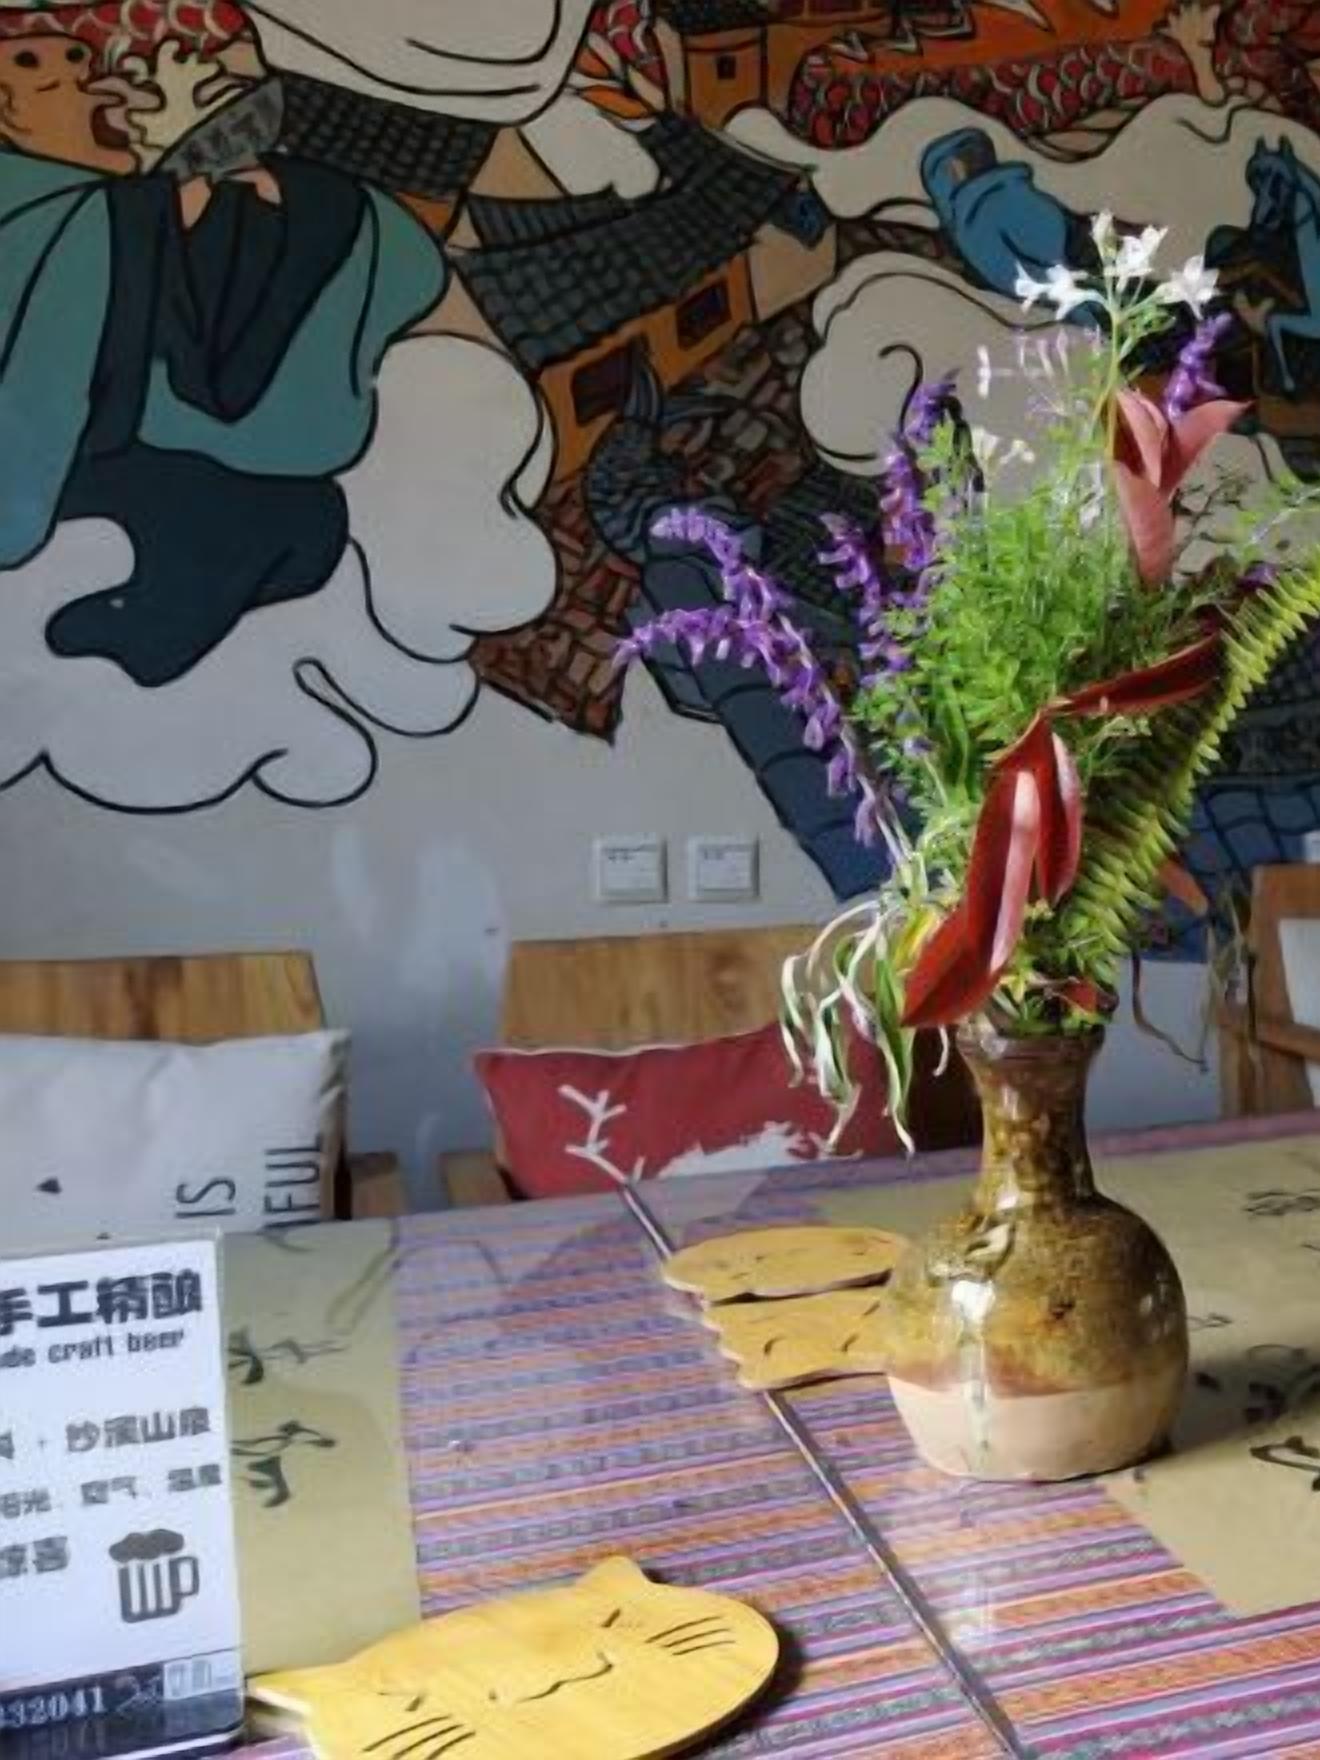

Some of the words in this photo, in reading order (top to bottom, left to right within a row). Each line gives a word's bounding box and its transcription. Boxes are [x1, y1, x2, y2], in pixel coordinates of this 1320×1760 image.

[176, 1178, 236, 1218] IS
[47, 1335, 115, 1364] craft
[128, 1329, 185, 1353] beer
